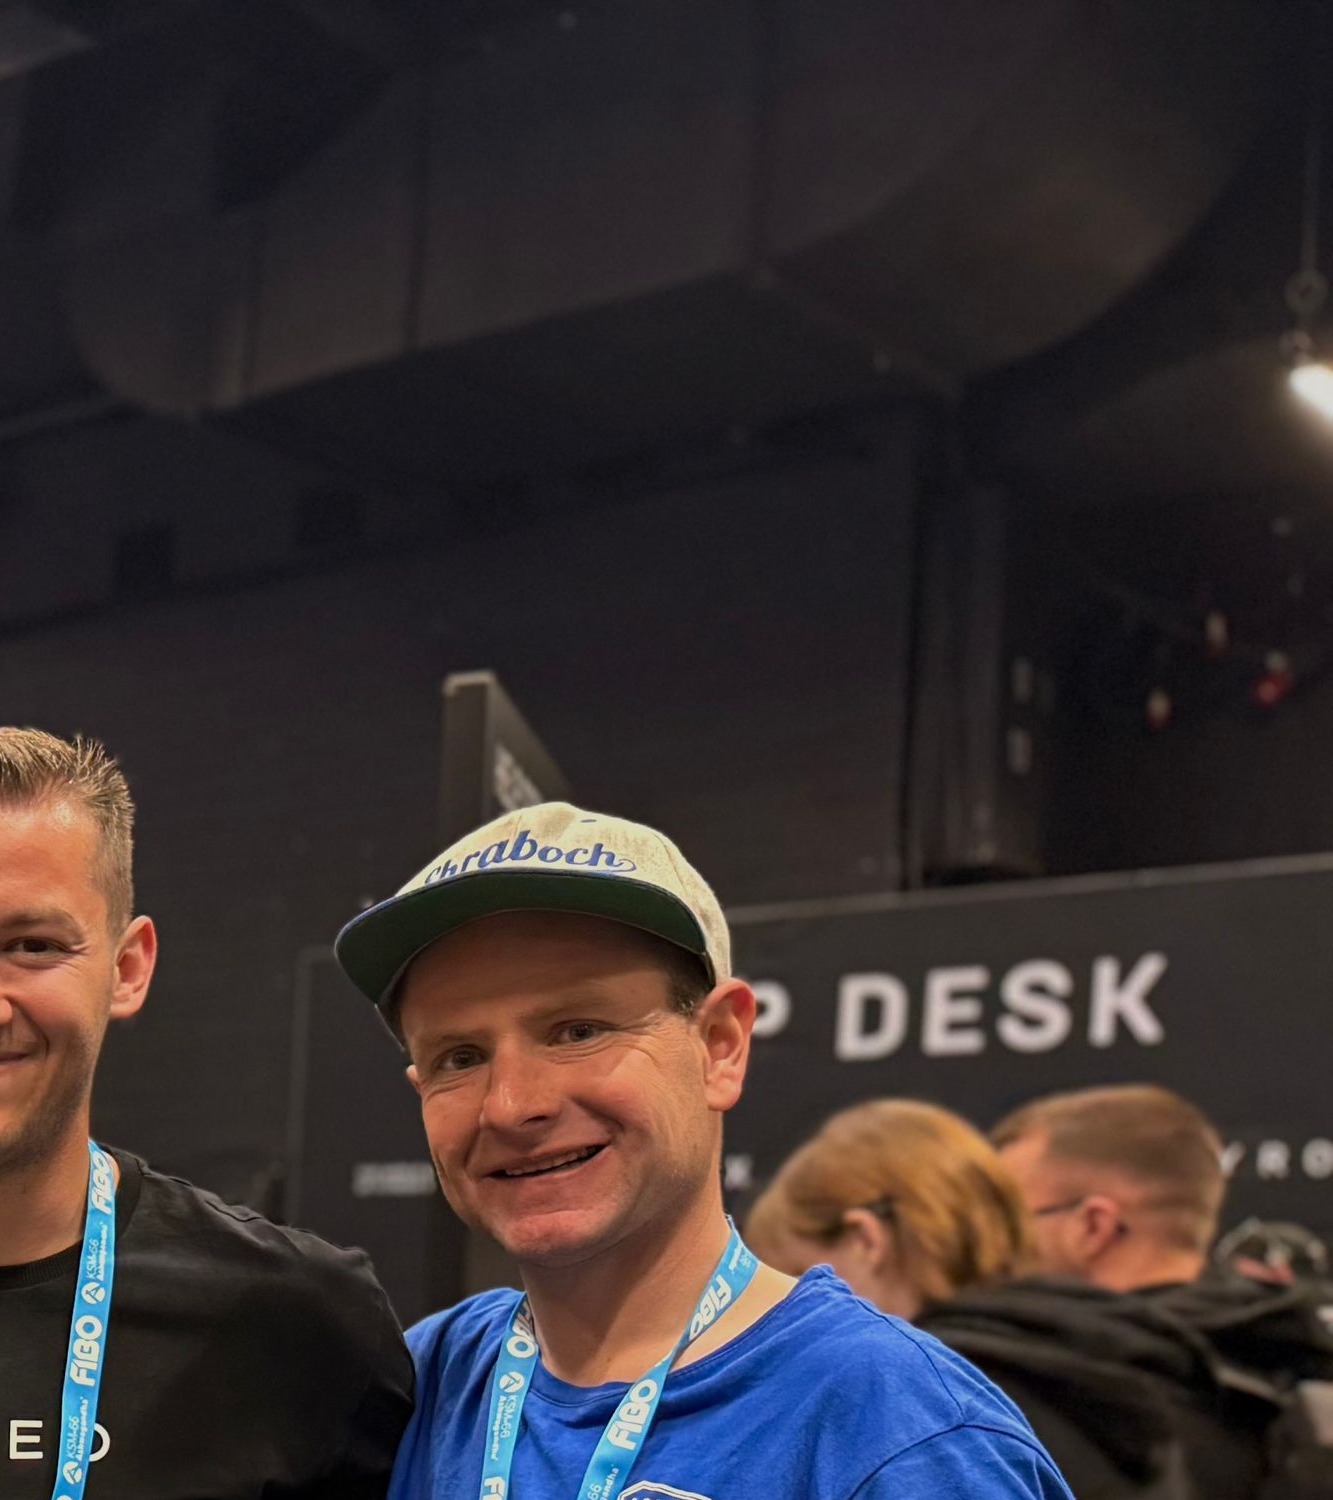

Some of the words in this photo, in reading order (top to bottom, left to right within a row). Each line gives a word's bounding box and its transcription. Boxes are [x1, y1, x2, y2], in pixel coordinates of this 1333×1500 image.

[835, 953, 1171, 1062] DESK
[91, 1151, 112, 1215] FIBO
[69, 1315, 103, 1387] FIBO
[66, 1416, 79, 1458] KSM-66
[607, 1379, 658, 1450] FIBO
